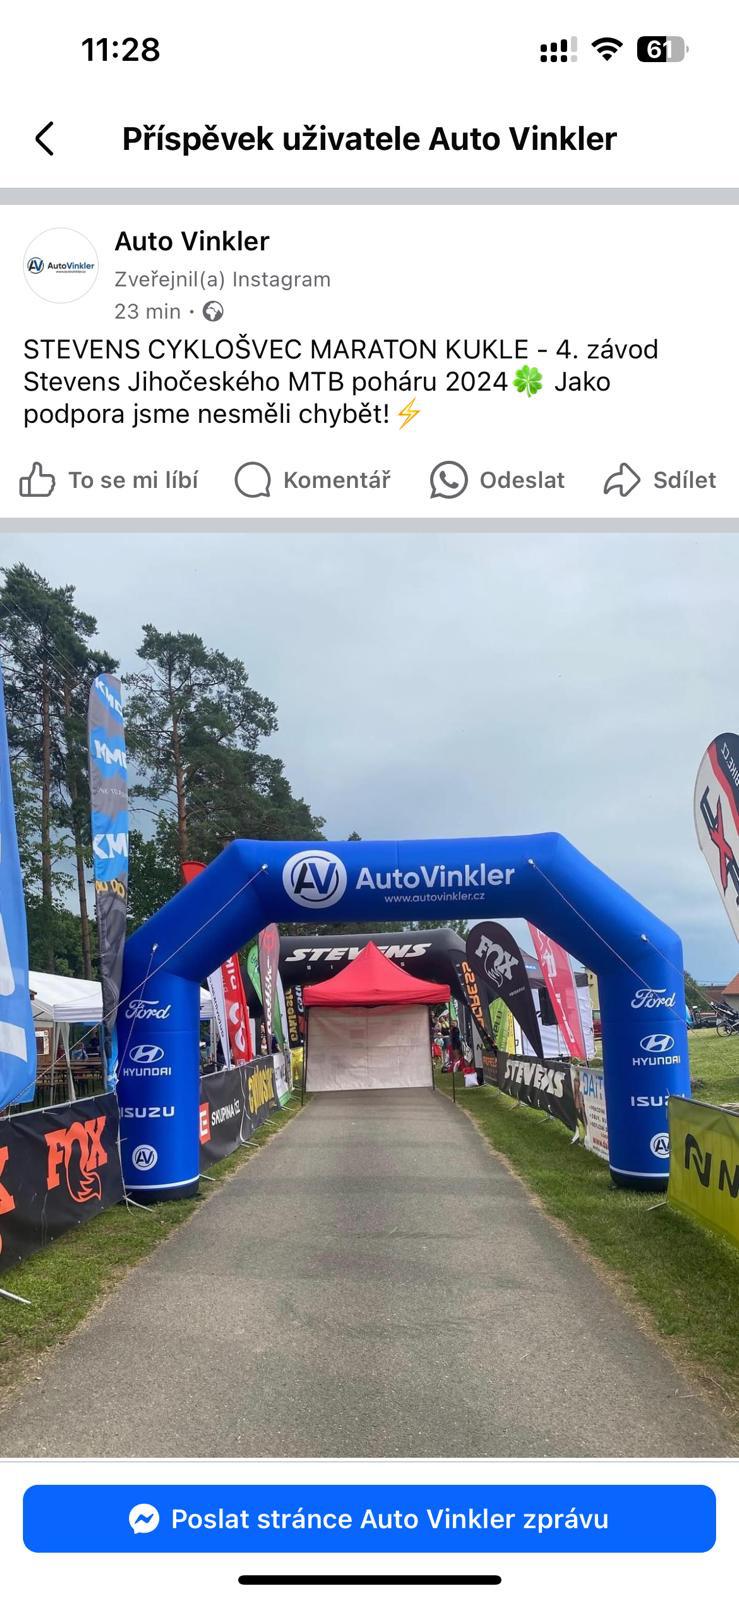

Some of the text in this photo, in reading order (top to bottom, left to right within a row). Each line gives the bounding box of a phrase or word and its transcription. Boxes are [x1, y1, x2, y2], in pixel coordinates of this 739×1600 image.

[81, 37, 161, 62] 11:28
[646, 40, 674, 60] 61
[123, 123, 618, 157] Příspěvek uživatele Auto Vinkler
[114, 229, 271, 252] Auto Vinkler
[47, 262, 95, 270] AutoVinkler
[114, 269, 331, 291] Zveřejnil(a) Instagram
[114, 302, 181, 320] 23 min
[23, 338, 141, 360] STEVENS
[148, 332, 302, 360] CYKLOŠVEC
[311, 338, 437, 360] MARATON
[446, 338, 529, 360] KUKLE
[555, 338, 578, 360] 4.
[587, 337, 658, 360] závod
[23, 369, 611, 397] Stevens Jihočeského MTB poháru 2024 Jako
[24, 401, 389, 429] podpora jsme nesměli chybět!
[68, 469, 199, 489] To se mi líbí
[284, 469, 391, 489] Komentář
[480, 470, 565, 489] Odeslat
[653, 469, 717, 489] Sdílet
[355, 862, 515, 890] AutoVinkler
[384, 891, 486, 904] www.autovinkler.cz
[475, 934, 519, 988] FOX
[631, 987, 676, 1009] Ford
[125, 999, 171, 1020] Ford
[123, 1067, 172, 1077] HYUNDAI
[632, 1055, 681, 1067] HYUNDAI
[504, 1060, 566, 1098] STEVENS
[120, 1106, 175, 1118] ISUZU
[44, 1116, 108, 1202] FOX
[172, 1506, 608, 1534] Poslat stránce Auto Vinkler zprávu
